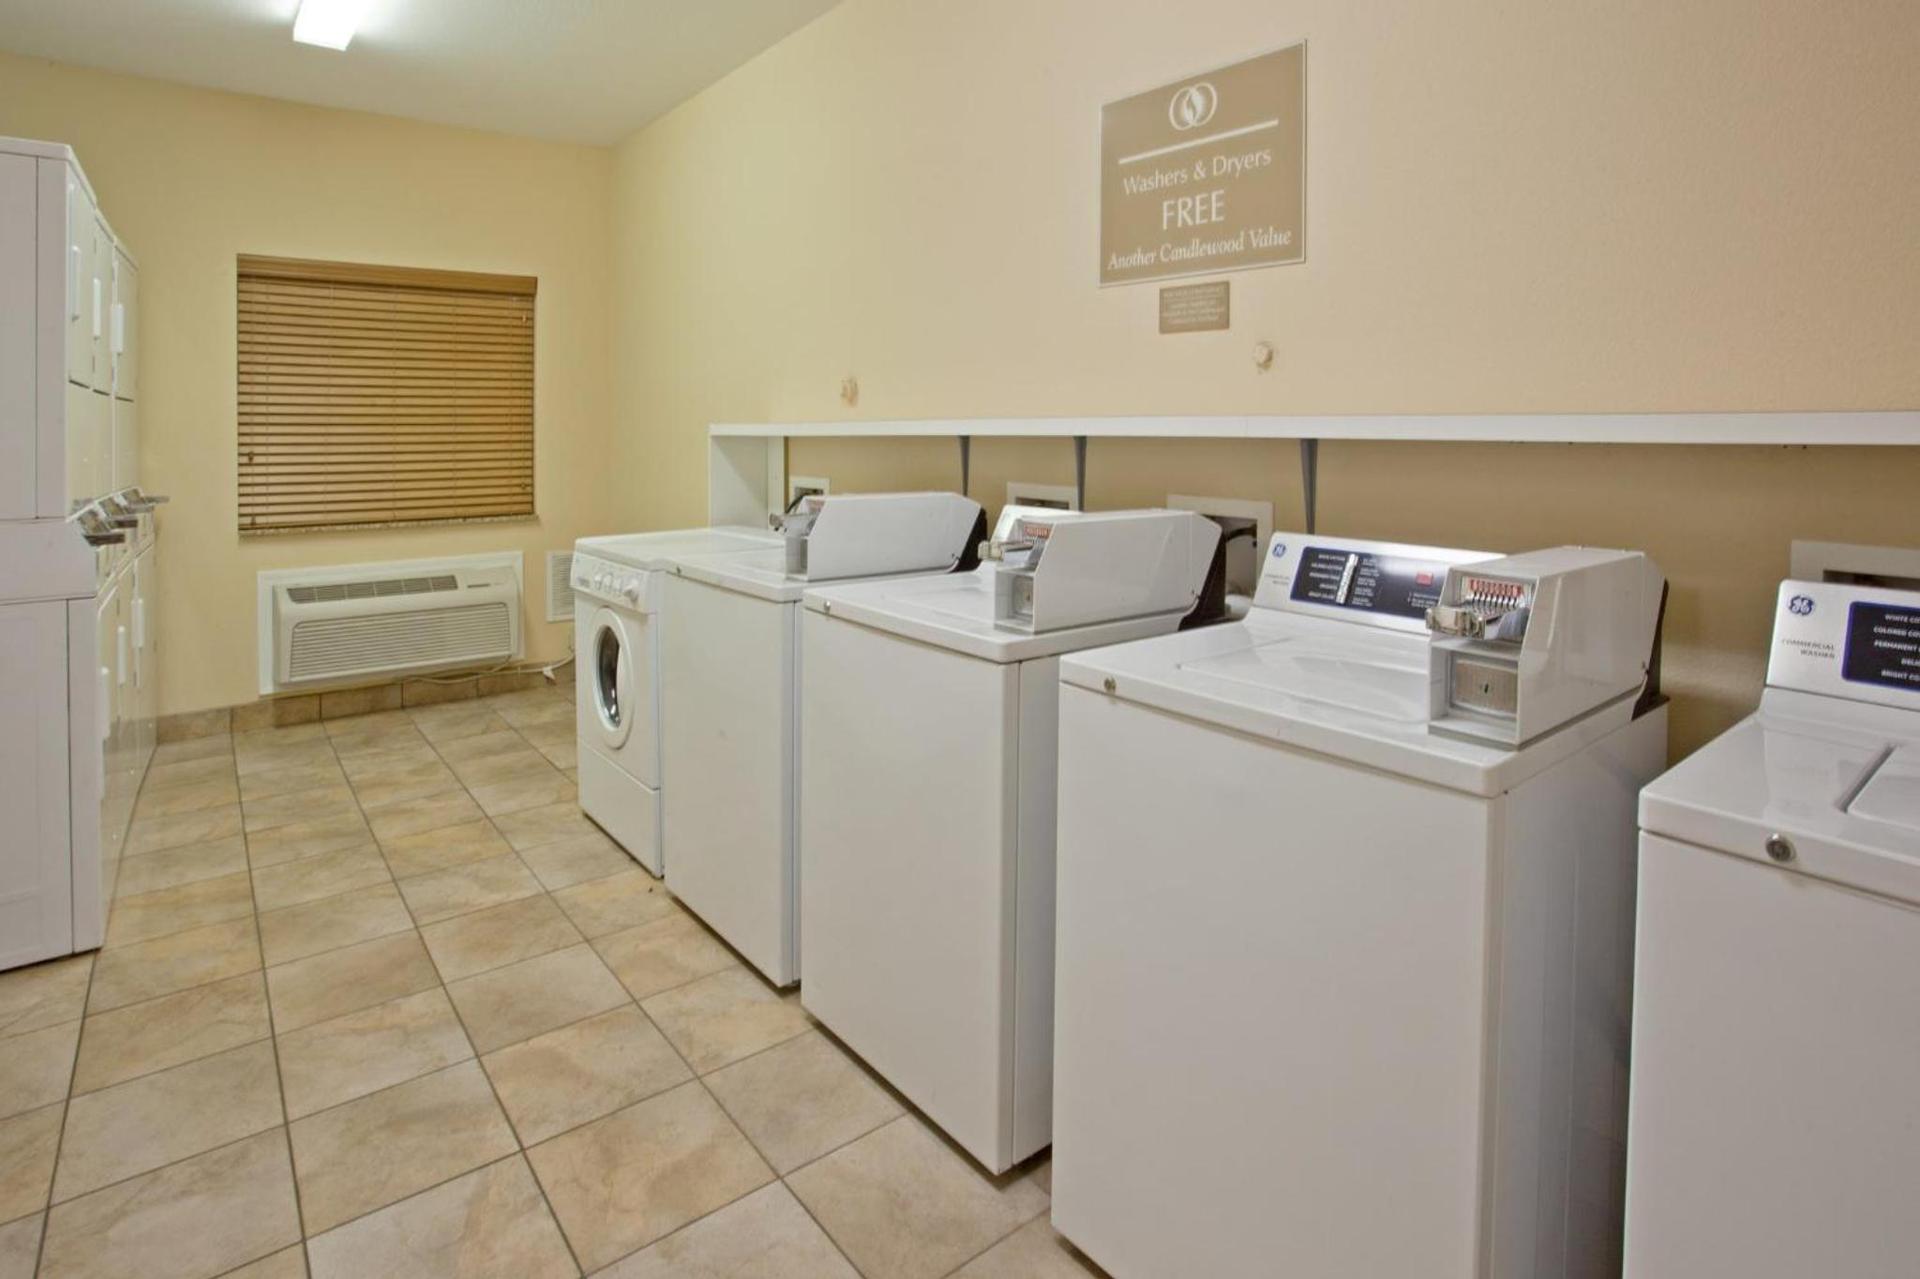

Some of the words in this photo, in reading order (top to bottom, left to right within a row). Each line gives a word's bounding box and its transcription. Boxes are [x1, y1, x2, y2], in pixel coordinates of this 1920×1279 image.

[1123, 168, 1188, 196] Washers
[1193, 159, 1206, 180] &
[1212, 149, 1272, 178] Dryers
[1161, 189, 1225, 231] FREE
[1107, 247, 1157, 271] Another
[1160, 231, 1245, 262] Candlewood
[1249, 226, 1292, 249] Value
